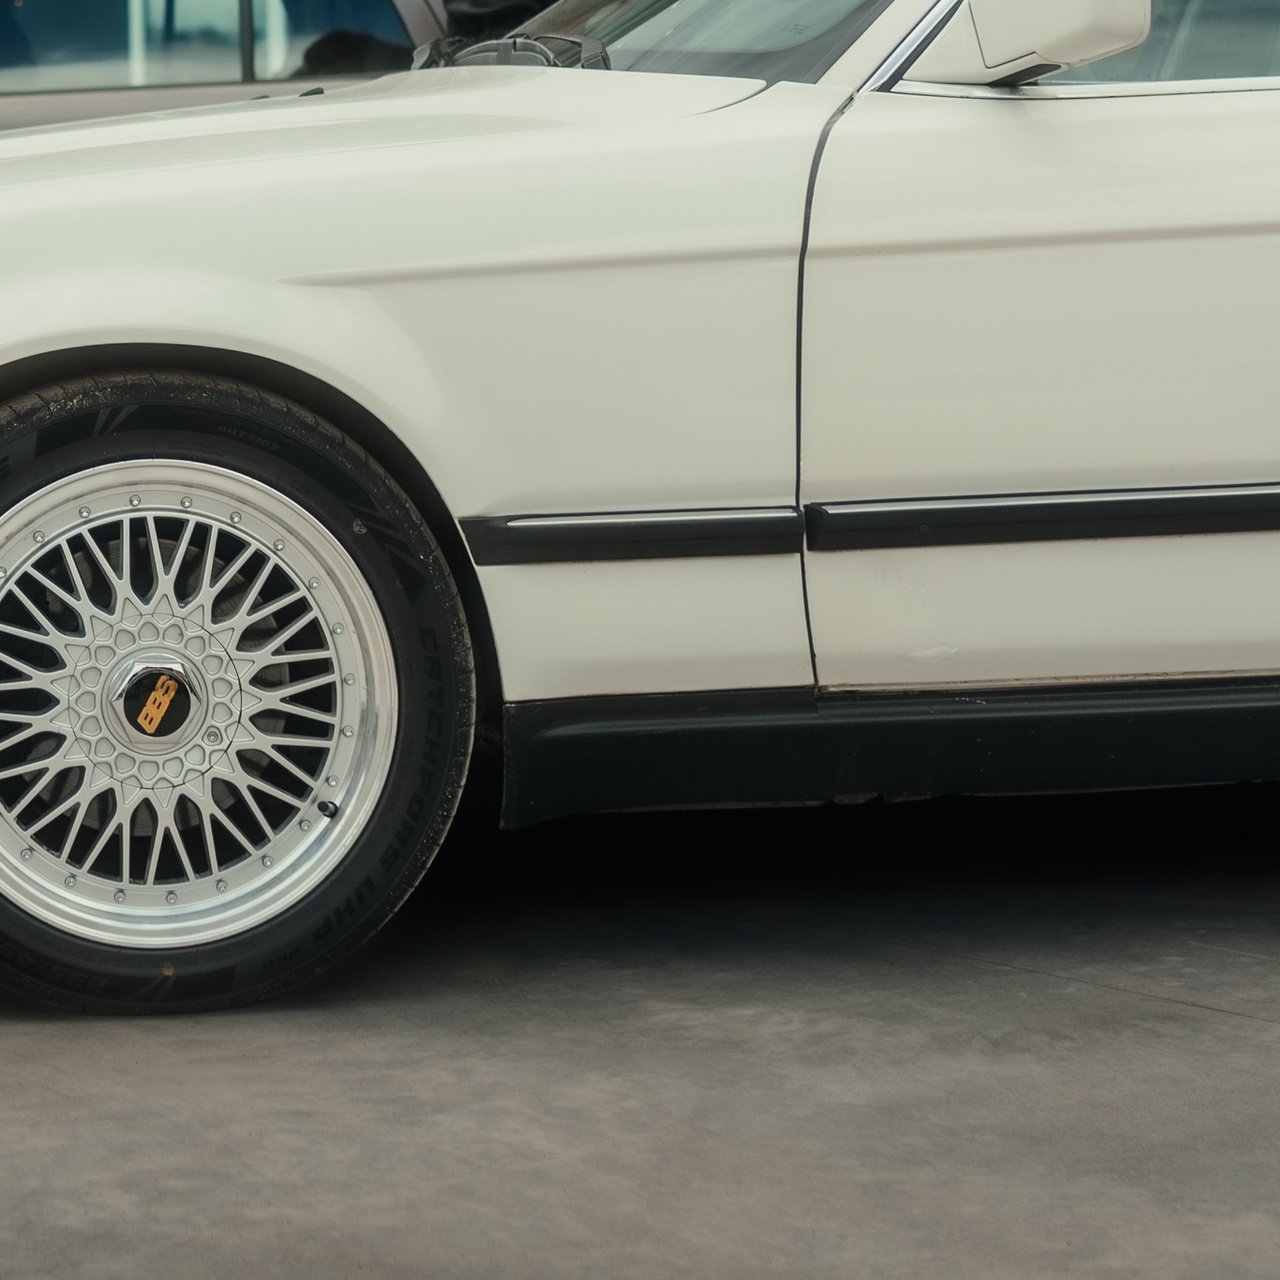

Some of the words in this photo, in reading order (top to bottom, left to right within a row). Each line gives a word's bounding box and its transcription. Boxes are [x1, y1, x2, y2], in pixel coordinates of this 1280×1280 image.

[216, 423, 281, 453] OUTSIDE
[136, 675, 179, 734] BBS
[375, 624, 444, 873] CATCHFORS
[307, 875, 381, 943] UHP
